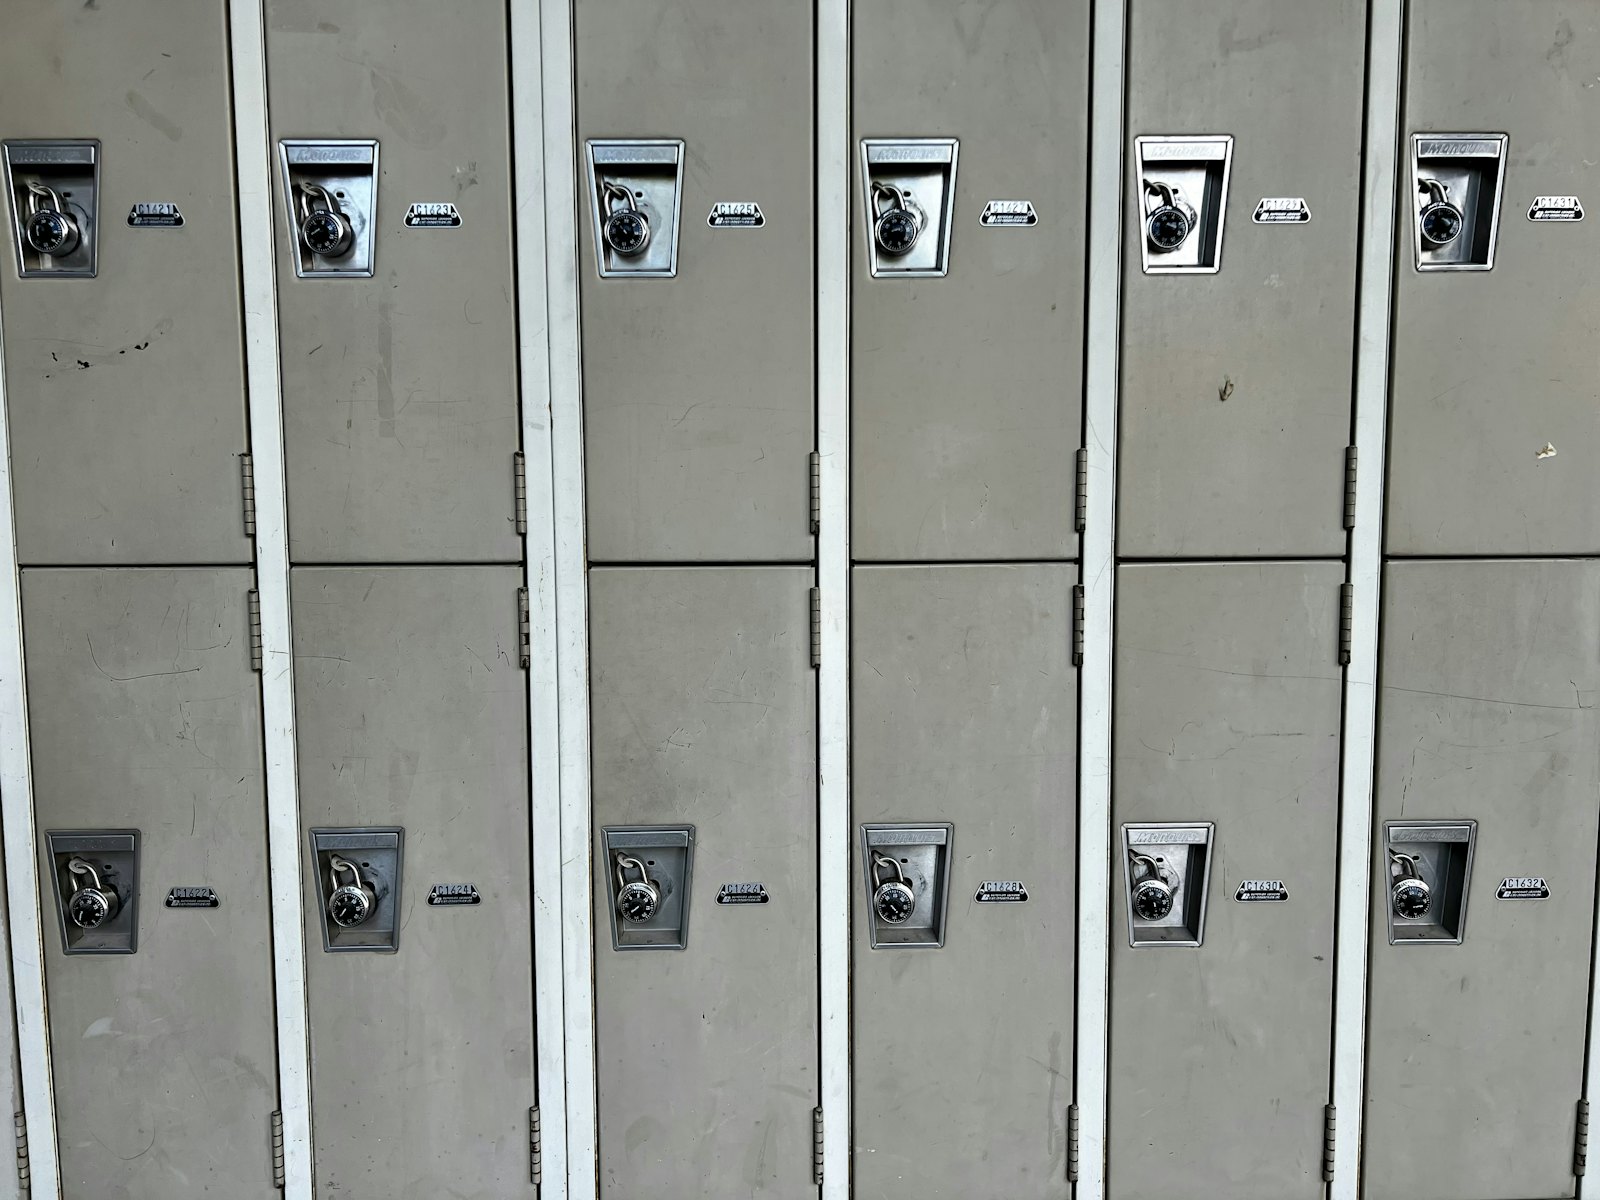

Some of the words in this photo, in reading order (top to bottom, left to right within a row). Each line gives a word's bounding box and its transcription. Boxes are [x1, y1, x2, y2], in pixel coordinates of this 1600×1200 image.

[992, 203, 1024, 213] C1627
[1265, 200, 1297, 210] C1629
[1540, 198, 1572, 208] C1631
[138, 204, 171, 214] C1621
[416, 204, 449, 214] C1623
[720, 204, 752, 214] C1625
[986, 882, 1017, 891] C1628
[1246, 881, 1278, 891] C1630
[1508, 878, 1539, 888] C1632
[175, 888, 207, 898] C1622
[437, 885, 469, 895] C1624
[727, 884, 758, 893] C1626
